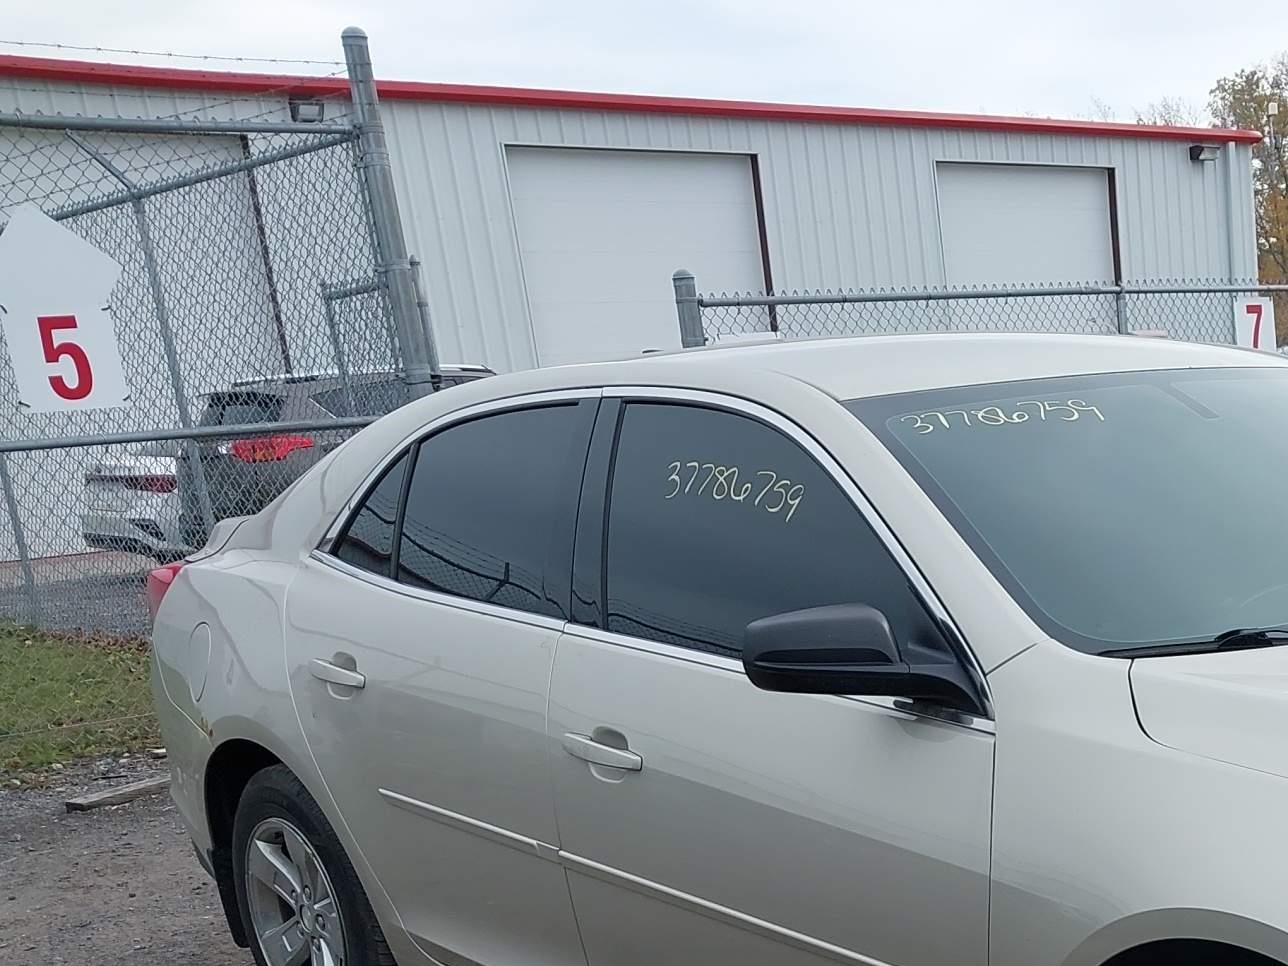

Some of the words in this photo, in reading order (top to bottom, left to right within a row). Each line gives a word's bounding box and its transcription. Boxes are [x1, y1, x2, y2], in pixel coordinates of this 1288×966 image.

[1246, 304, 1263, 349] 7
[37, 315, 94, 401] 5
[901, 399, 1105, 434] 37786759
[664, 461, 805, 523] 37786759
